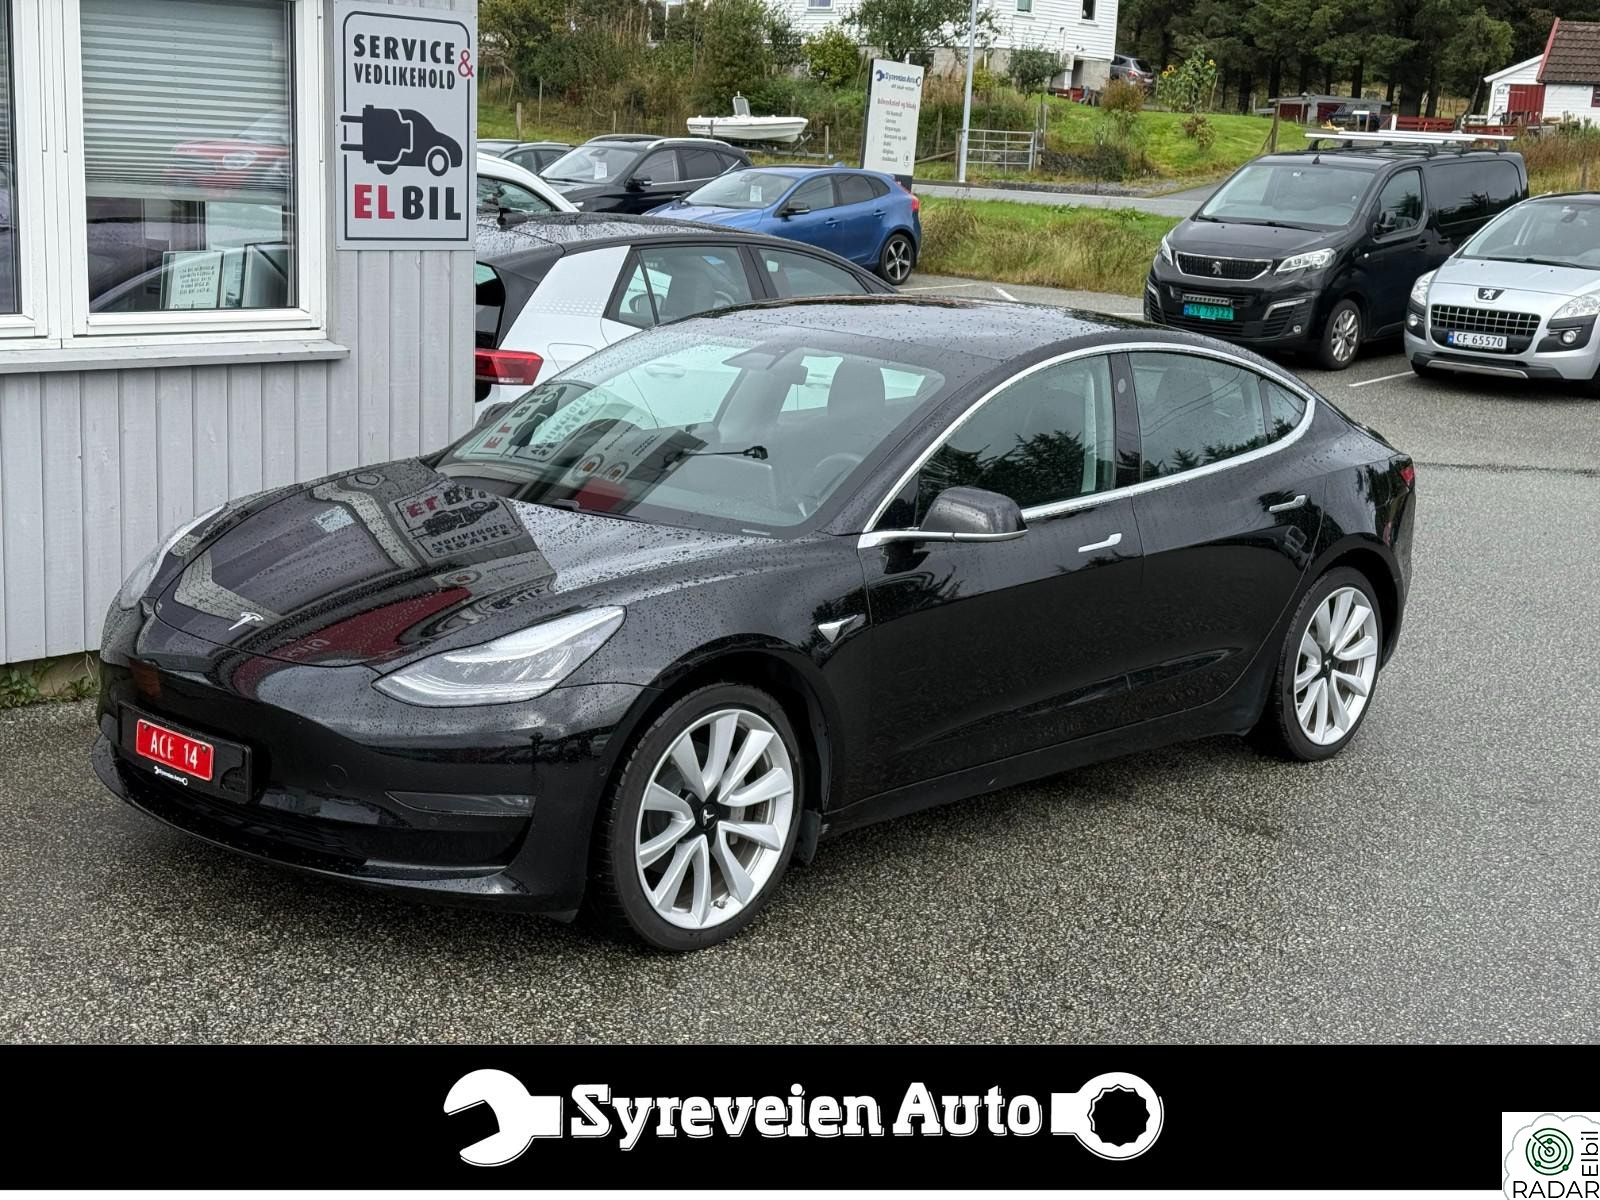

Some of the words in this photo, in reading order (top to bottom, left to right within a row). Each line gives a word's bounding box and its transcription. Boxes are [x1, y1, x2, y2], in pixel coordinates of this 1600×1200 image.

[353, 33, 455, 65] SERVICE
[457, 49, 475, 78] &
[353, 62, 456, 90] VEDLIKEHOLD
[1456, 333, 1468, 343] CF
[1472, 335, 1504, 347] 65570
[183, 742, 198, 770] 14
